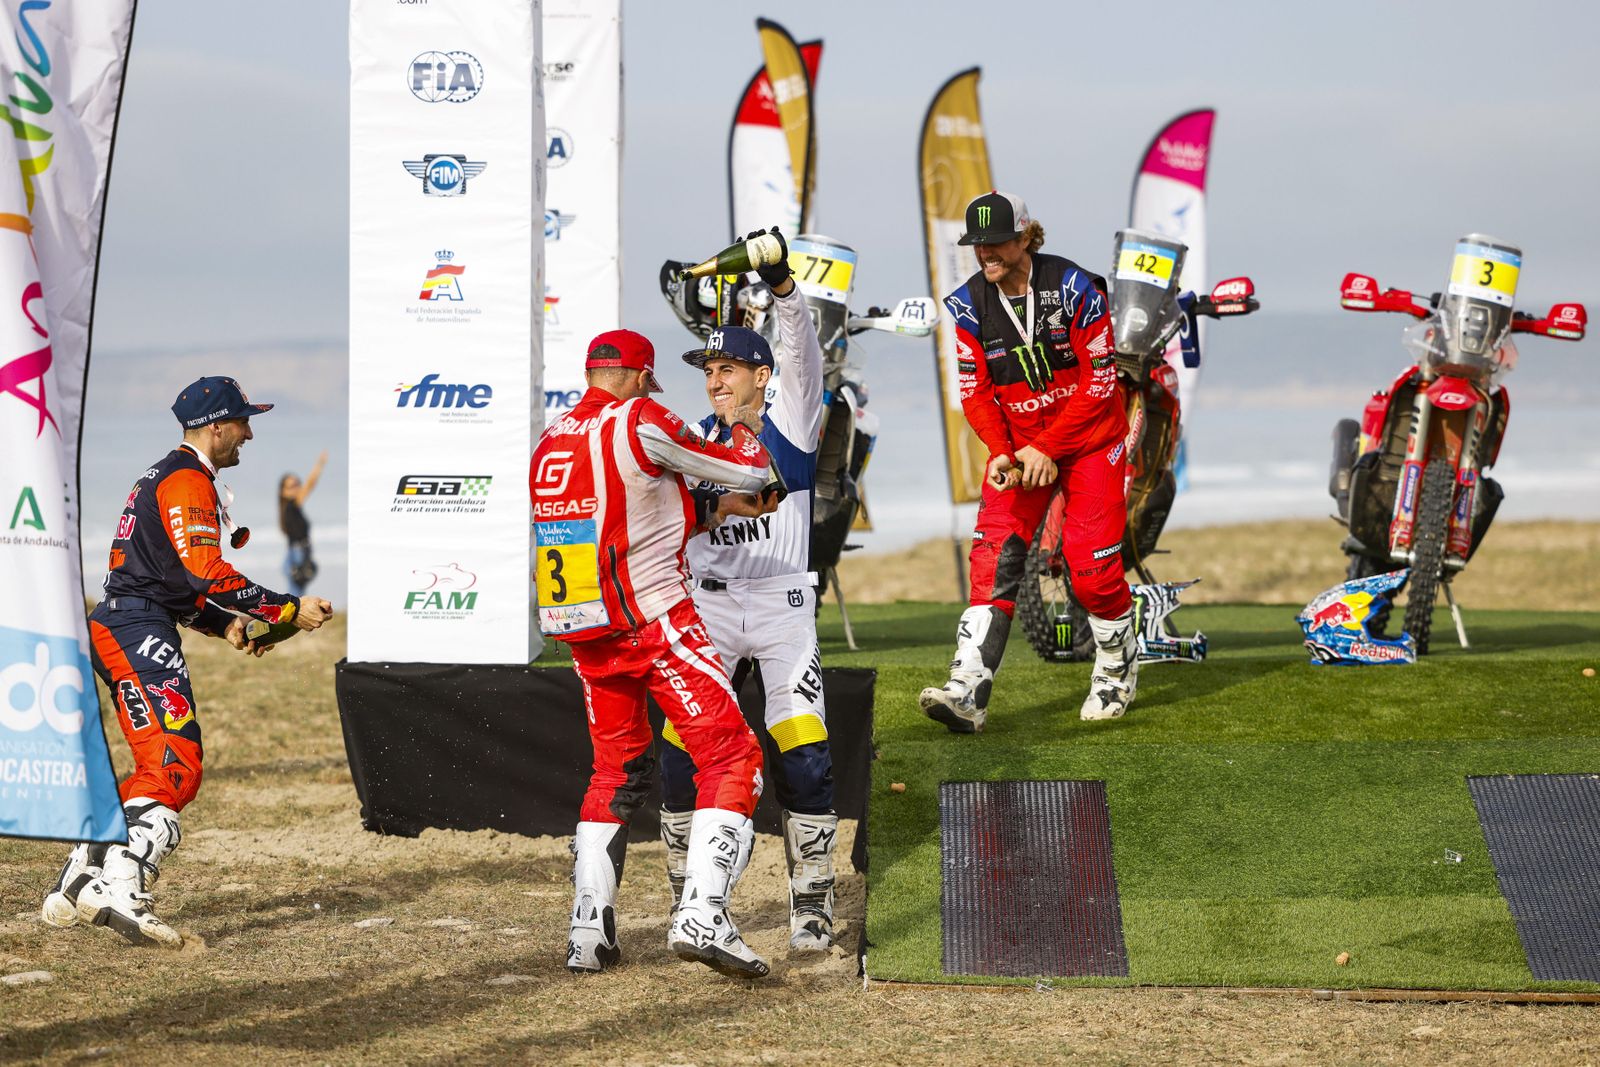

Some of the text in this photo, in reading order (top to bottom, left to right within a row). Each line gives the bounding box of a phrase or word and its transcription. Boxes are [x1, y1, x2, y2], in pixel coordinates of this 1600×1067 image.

[431, 167, 459, 185] FIM
[803, 255, 833, 284] 77
[1134, 253, 1158, 275] 42
[1479, 261, 1495, 287] 3
[1217, 304, 1245, 313] MOTUL
[187, 408, 229, 427] FACTORY RACING
[445, 497, 486, 505] andaluza
[168, 505, 189, 558] KENNY
[544, 535, 566, 545] RALLY
[709, 516, 771, 546] KENNY
[207, 577, 247, 594] KTM
[546, 548, 567, 604] 3
[403, 591, 479, 610] FAM
[1350, 641, 1404, 660] Red Bull
[118, 679, 151, 731] KTM
[708, 835, 738, 859] FOX
[754, 962, 770, 975] FOX
